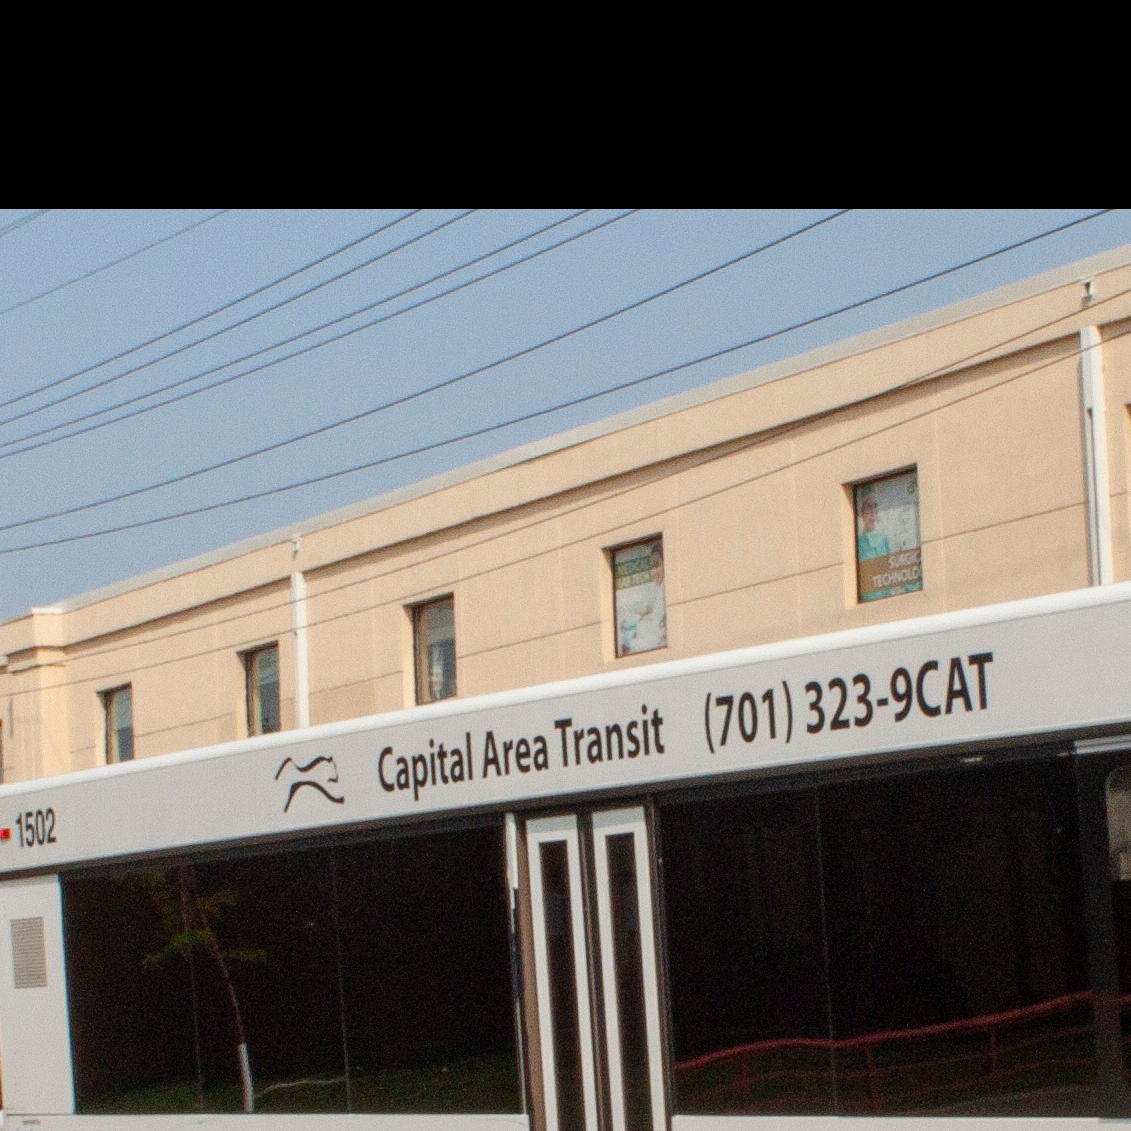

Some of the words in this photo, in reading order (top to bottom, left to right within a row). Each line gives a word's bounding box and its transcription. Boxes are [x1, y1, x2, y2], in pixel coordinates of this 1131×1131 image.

[704, 679, 793, 754] (701)
[805, 652, 994, 735] 323-9CAT
[378, 731, 473, 801] Capital
[483, 721, 550, 779] Area
[554, 704, 665, 767] Transit
[15, 807, 57, 848] 1502
